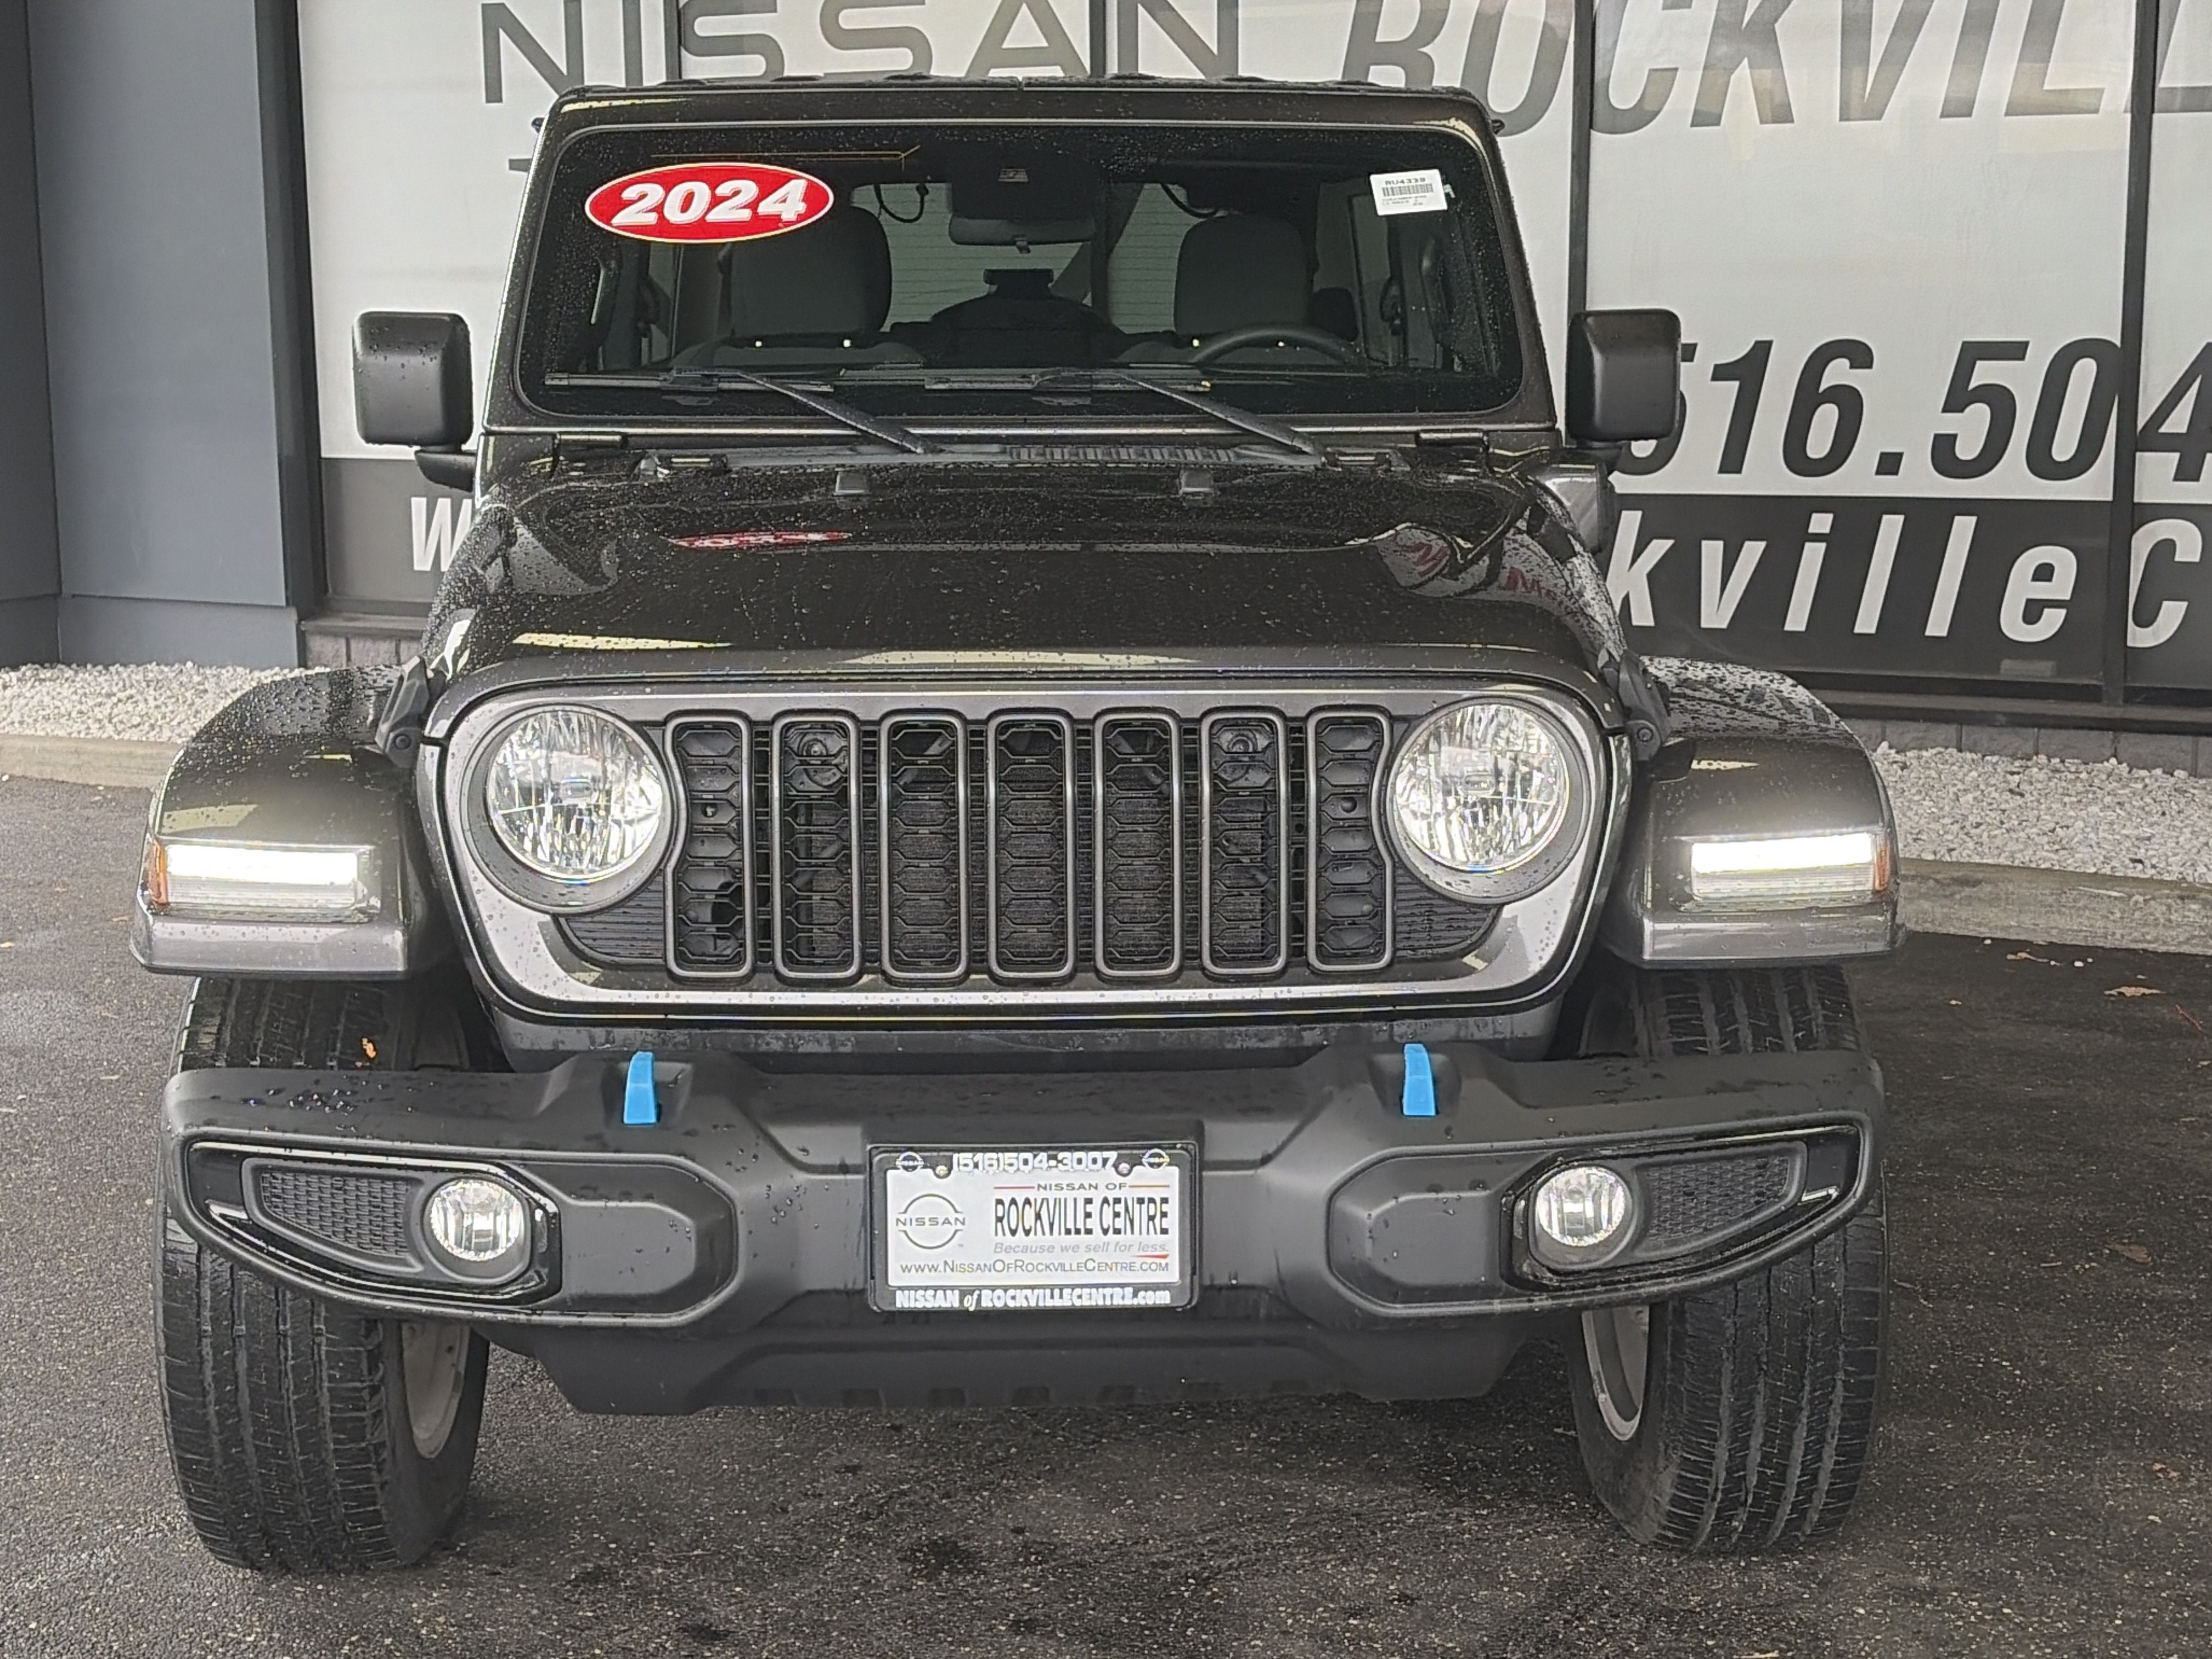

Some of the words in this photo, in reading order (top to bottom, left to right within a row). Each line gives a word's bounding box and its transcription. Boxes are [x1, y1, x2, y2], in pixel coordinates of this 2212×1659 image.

[481, 0, 1239, 103] NISSAN
[611, 178, 808, 226] 2024
[896, 1217, 966, 1226] NISSAN
[995, 1197, 1093, 1237] ROCKVILLE
[1099, 1196, 1169, 1235] CENTRE
[994, 1243, 1056, 1254] Because
[1060, 1244, 1080, 1252] we
[1084, 1242, 1110, 1252] sell
[1114, 1241, 1133, 1252] for
[1137, 1241, 1169, 1252] less.
[896, 1290, 960, 1308] NISSAN
[963, 1289, 980, 1311] of
